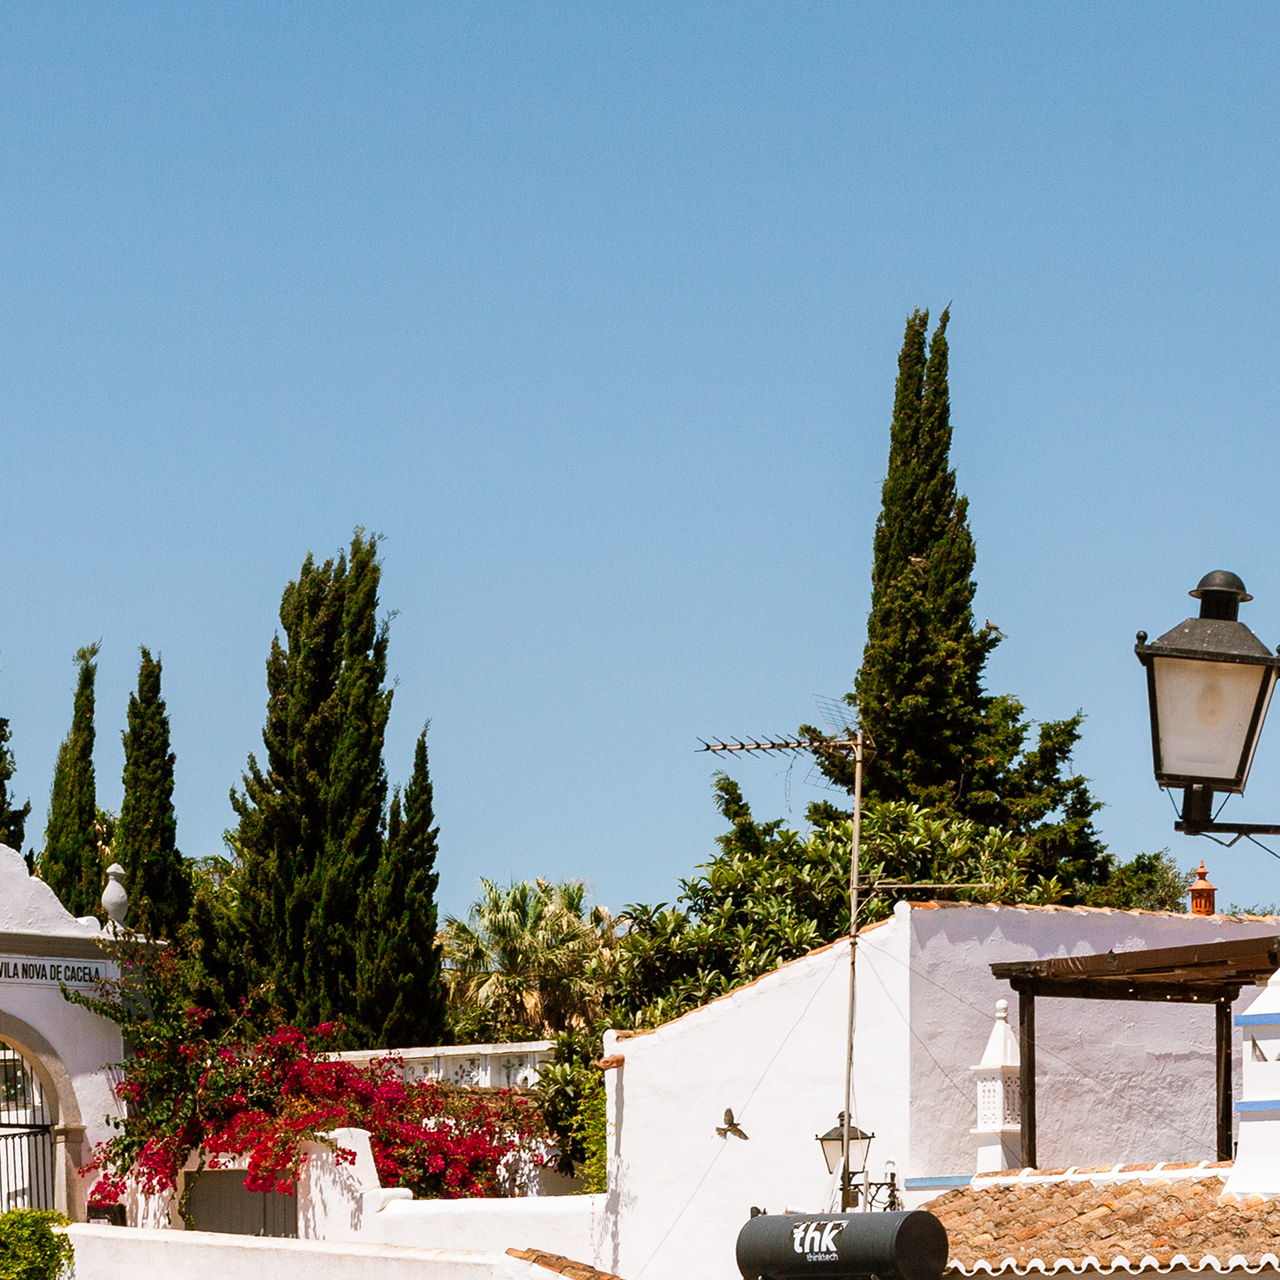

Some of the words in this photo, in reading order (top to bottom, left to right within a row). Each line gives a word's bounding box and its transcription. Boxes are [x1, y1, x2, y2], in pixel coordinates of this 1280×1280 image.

[21, 963, 48, 980] NOVA
[49, 965, 63, 981] DE
[64, 965, 100, 982] CACELA
[793, 1221, 843, 1254] thk
